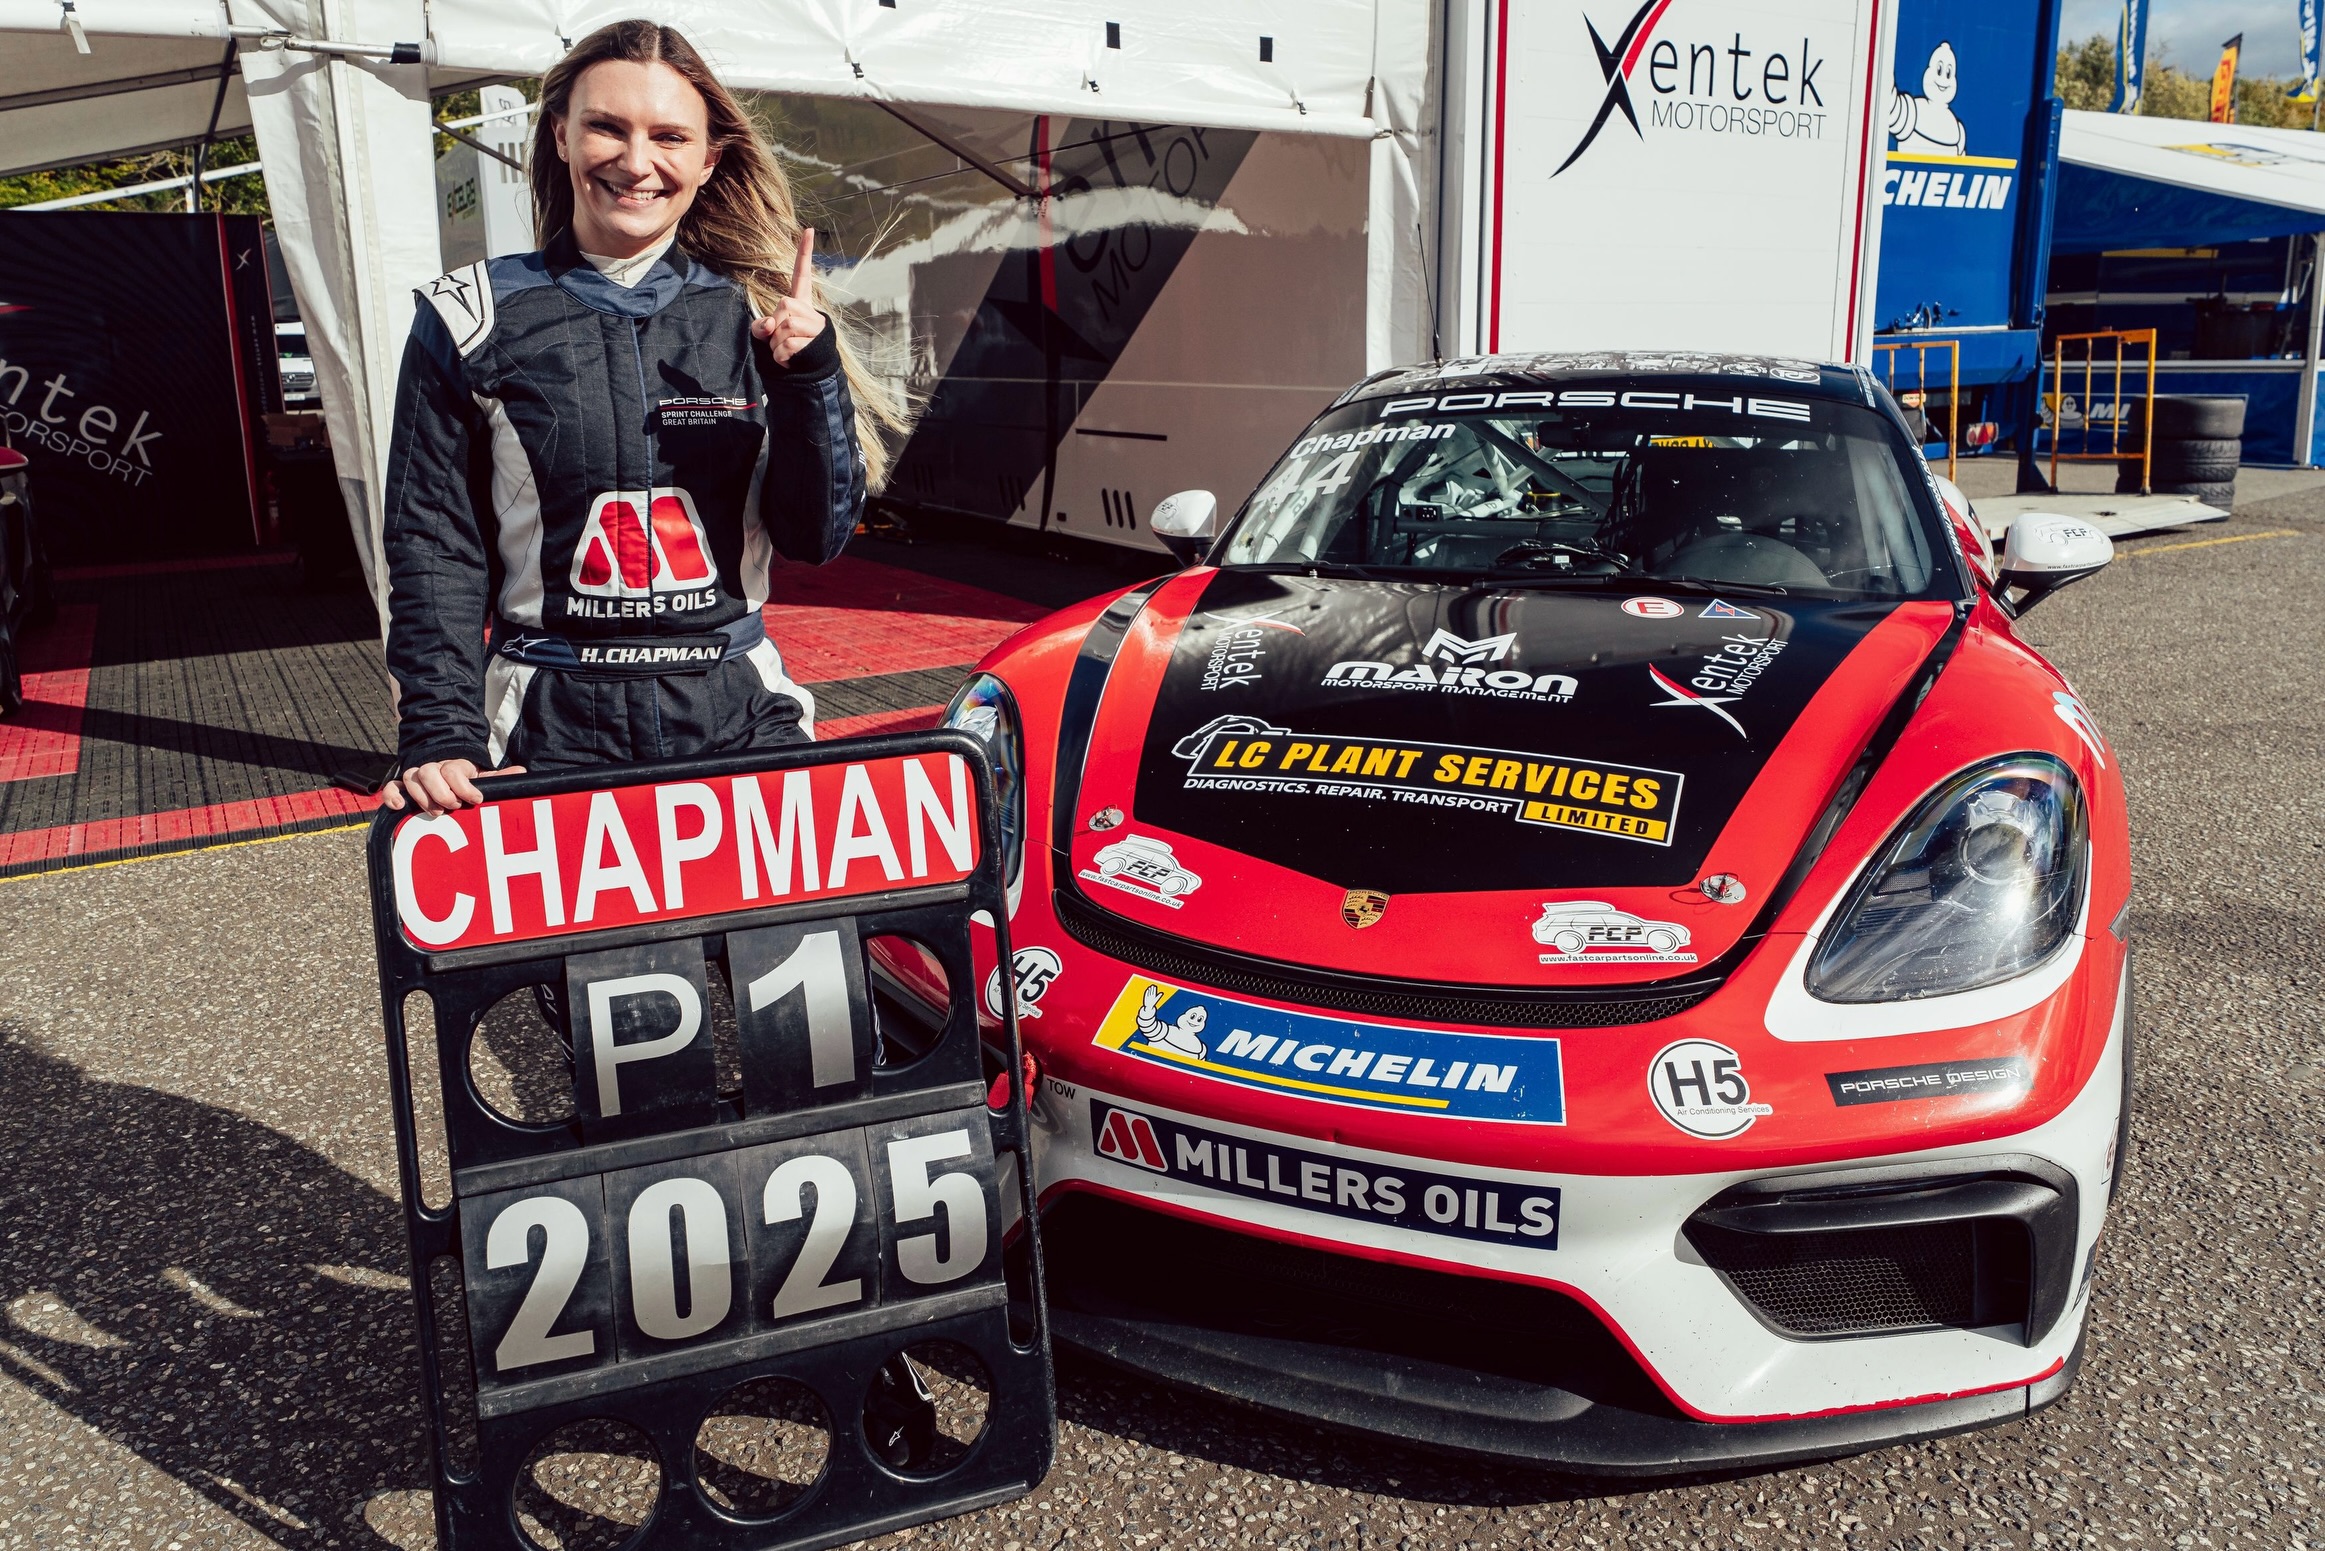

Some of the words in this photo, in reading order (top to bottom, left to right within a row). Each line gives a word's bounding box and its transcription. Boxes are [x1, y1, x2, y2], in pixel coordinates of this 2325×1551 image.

[1652, 99, 1827, 140] MOTORSPORT
[1883, 168, 2013, 210] CHELIN
[0, 358, 163, 467] ntek
[659, 397, 747, 406] PORSCHE
[661, 411, 689, 419] SPRINT
[690, 410, 733, 418] CHALLENGE
[1380, 391, 1811, 422] PORSCHE
[2090, 403, 2131, 419] MI
[688, 418, 717, 426] BRITAIN
[0, 403, 153, 487] ORSPORT
[1289, 423, 1457, 460] Chapman
[1253, 450, 1361, 504] 44
[566, 595, 666, 619] MILLERS
[671, 588, 717, 611] OILS
[1637, 602, 1669, 615] E
[580, 646, 722, 664] H.CHAPMAN
[1200, 632, 1234, 691] MOTORSPORT
[1725, 638, 1789, 695] MOTORSPORT
[1321, 677, 1438, 692] MOTORSPORT
[1441, 685, 1575, 704] MANAGEMENT
[1213, 740, 1272, 769] LC
[1278, 742, 1424, 779] PLANT
[1433, 753, 1661, 810] SERVICES
[1183, 778, 1311, 794] DIAGNOSTICS.
[1315, 784, 1387, 800] REPAIR.
[1392, 790, 1513, 815] TRANSPORT
[1540, 805, 1650, 835] LIMITED
[395, 753, 976, 947] CHAPMAN
[1127, 860, 1171, 879] FCP
[1080, 871, 1182, 908] www.fastcarpartsonline.co.uk
[1588, 926, 1643, 941] FCP
[1540, 953, 1697, 963] www.fastcarpartsonline.co.uk
[997, 955, 1057, 1003] H5
[1215, 1028, 1518, 1093] MICHELIN
[1047, 1077, 1076, 1100] TOW
[1664, 1059, 1747, 1107] H5
[1840, 1074, 1942, 1094] PORSCHE
[1946, 1067, 2021, 1085] DESIGN
[1689, 1106, 1736, 1116] Conditioning
[1738, 1105, 1770, 1114] Services
[1175, 1132, 1406, 1216] MILLERS
[1423, 1184, 1555, 1237] OILS
[486, 1128, 989, 1372] 2025
